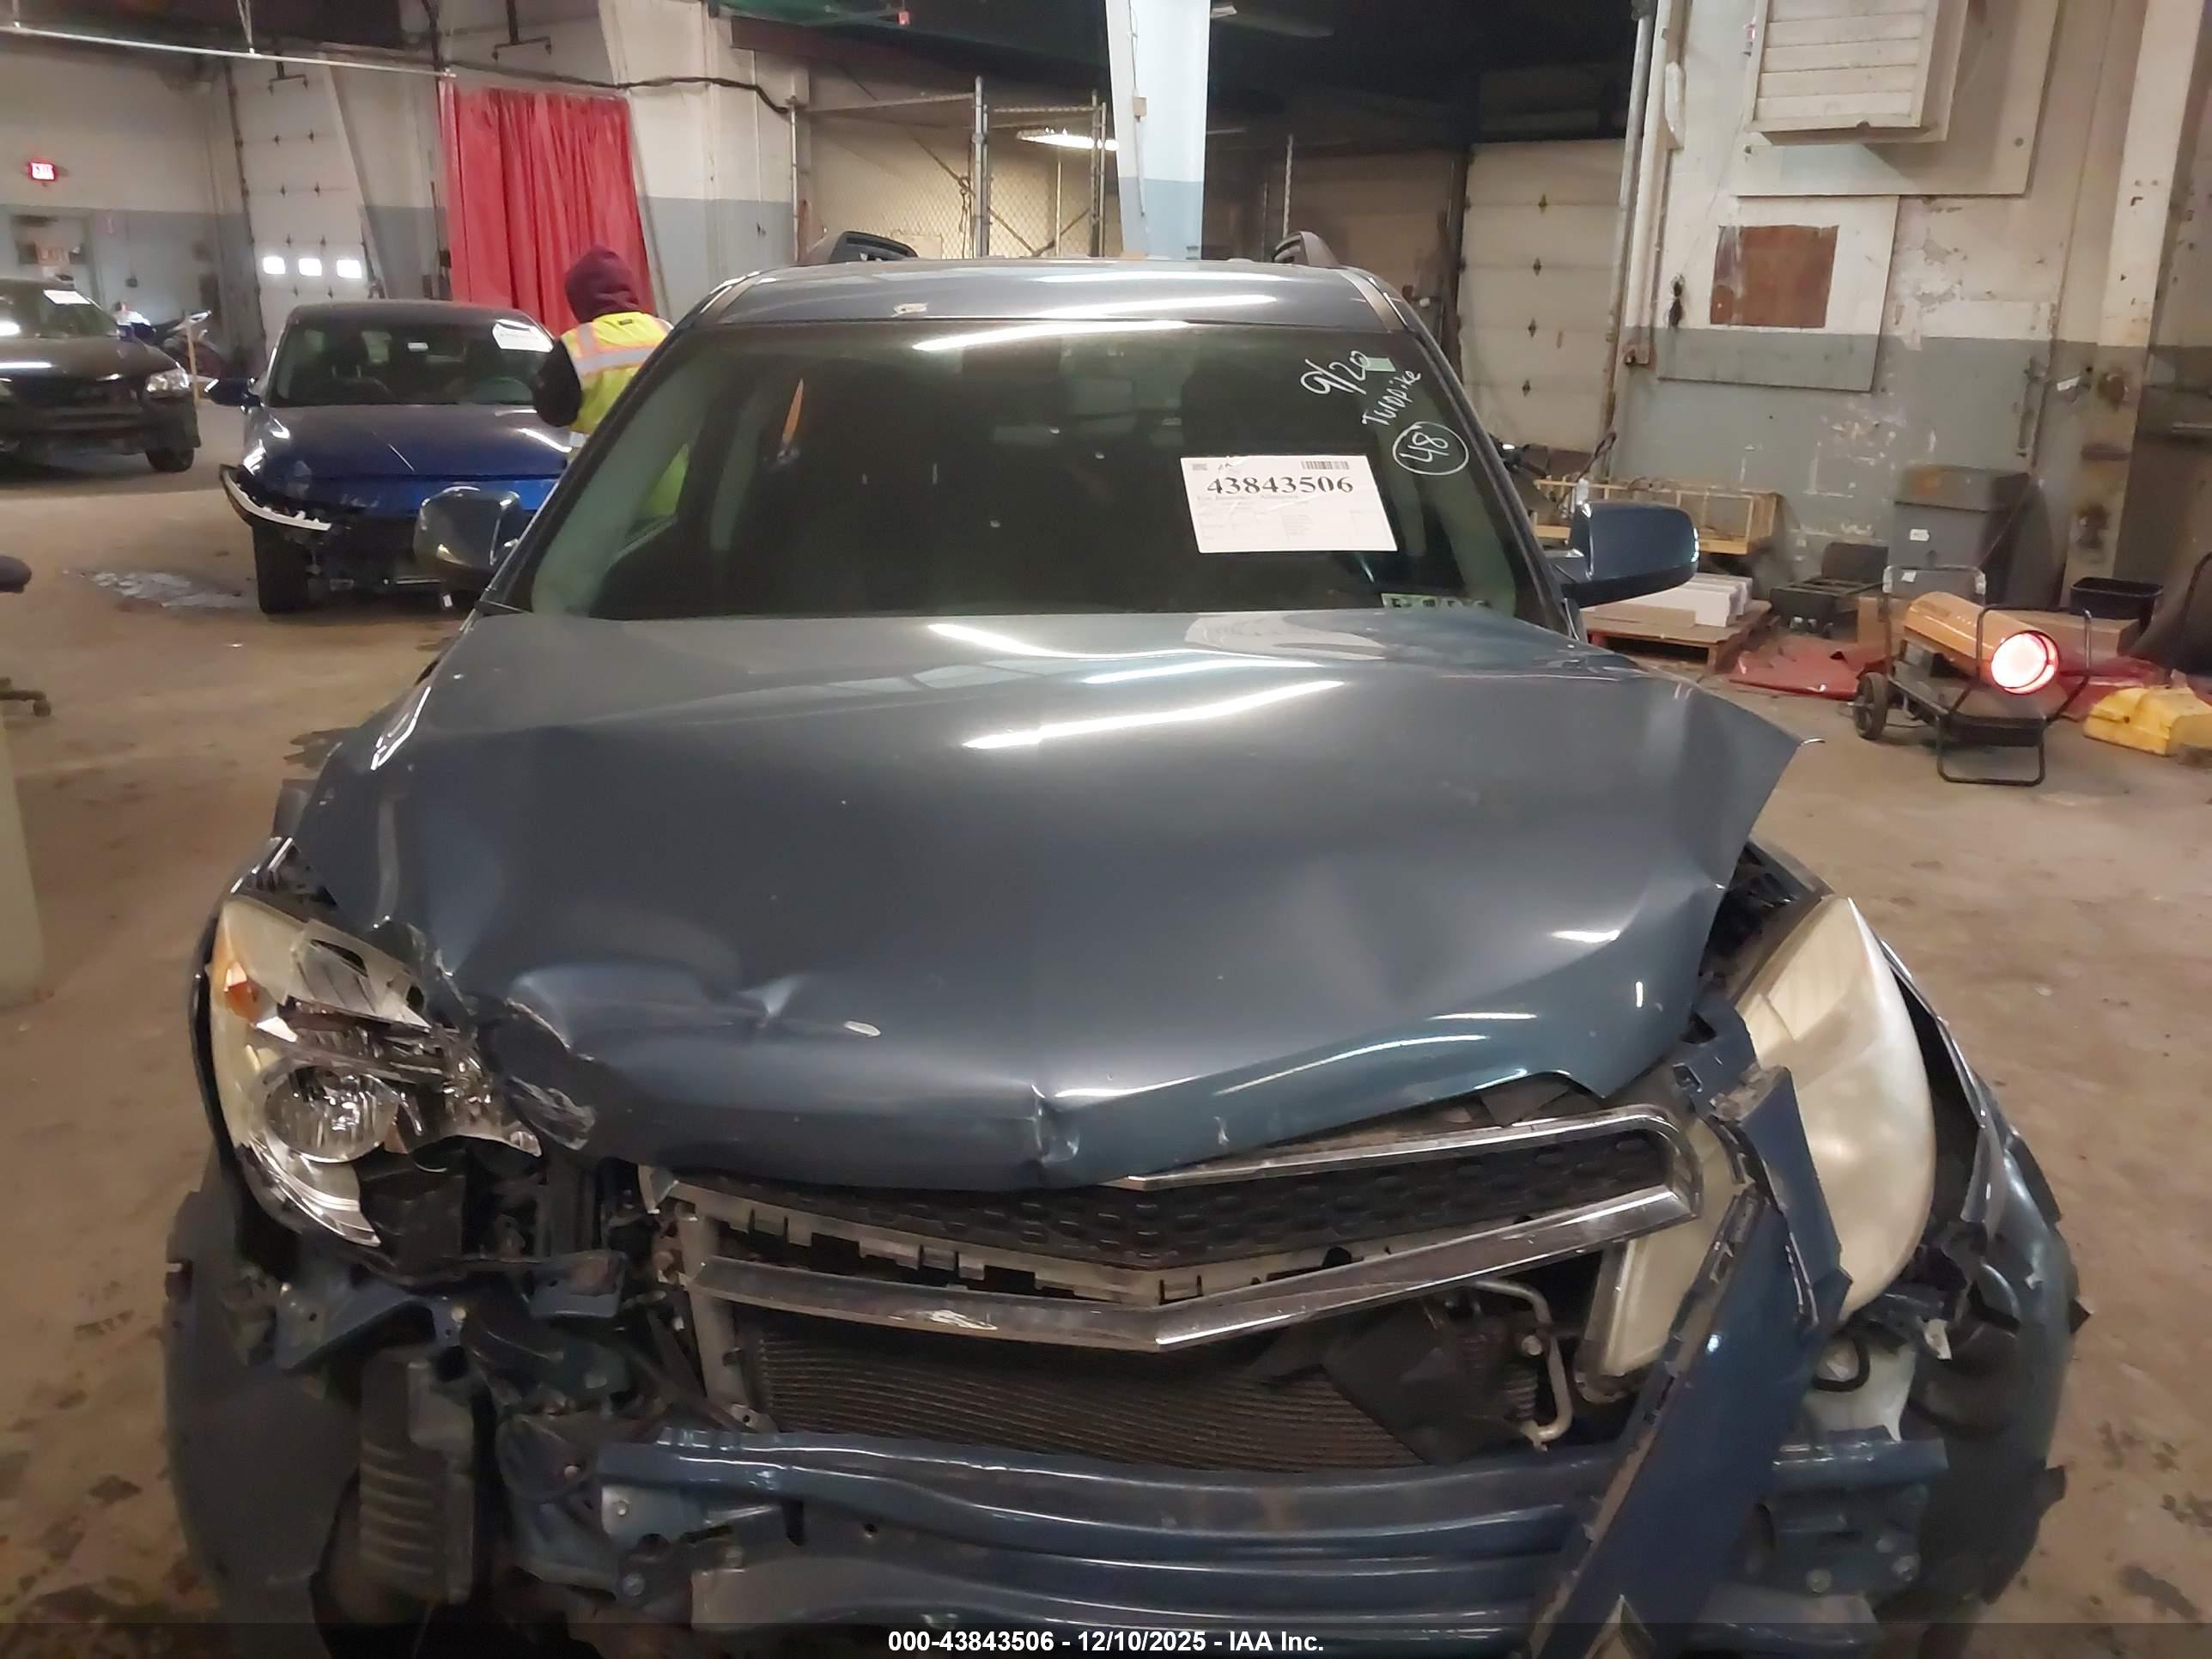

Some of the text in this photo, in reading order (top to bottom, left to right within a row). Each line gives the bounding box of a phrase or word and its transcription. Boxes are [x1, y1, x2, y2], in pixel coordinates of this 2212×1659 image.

[1300, 349, 1371, 396] 9/20
[1398, 430, 1450, 464] 48
[1206, 476, 1354, 495] 43843506
